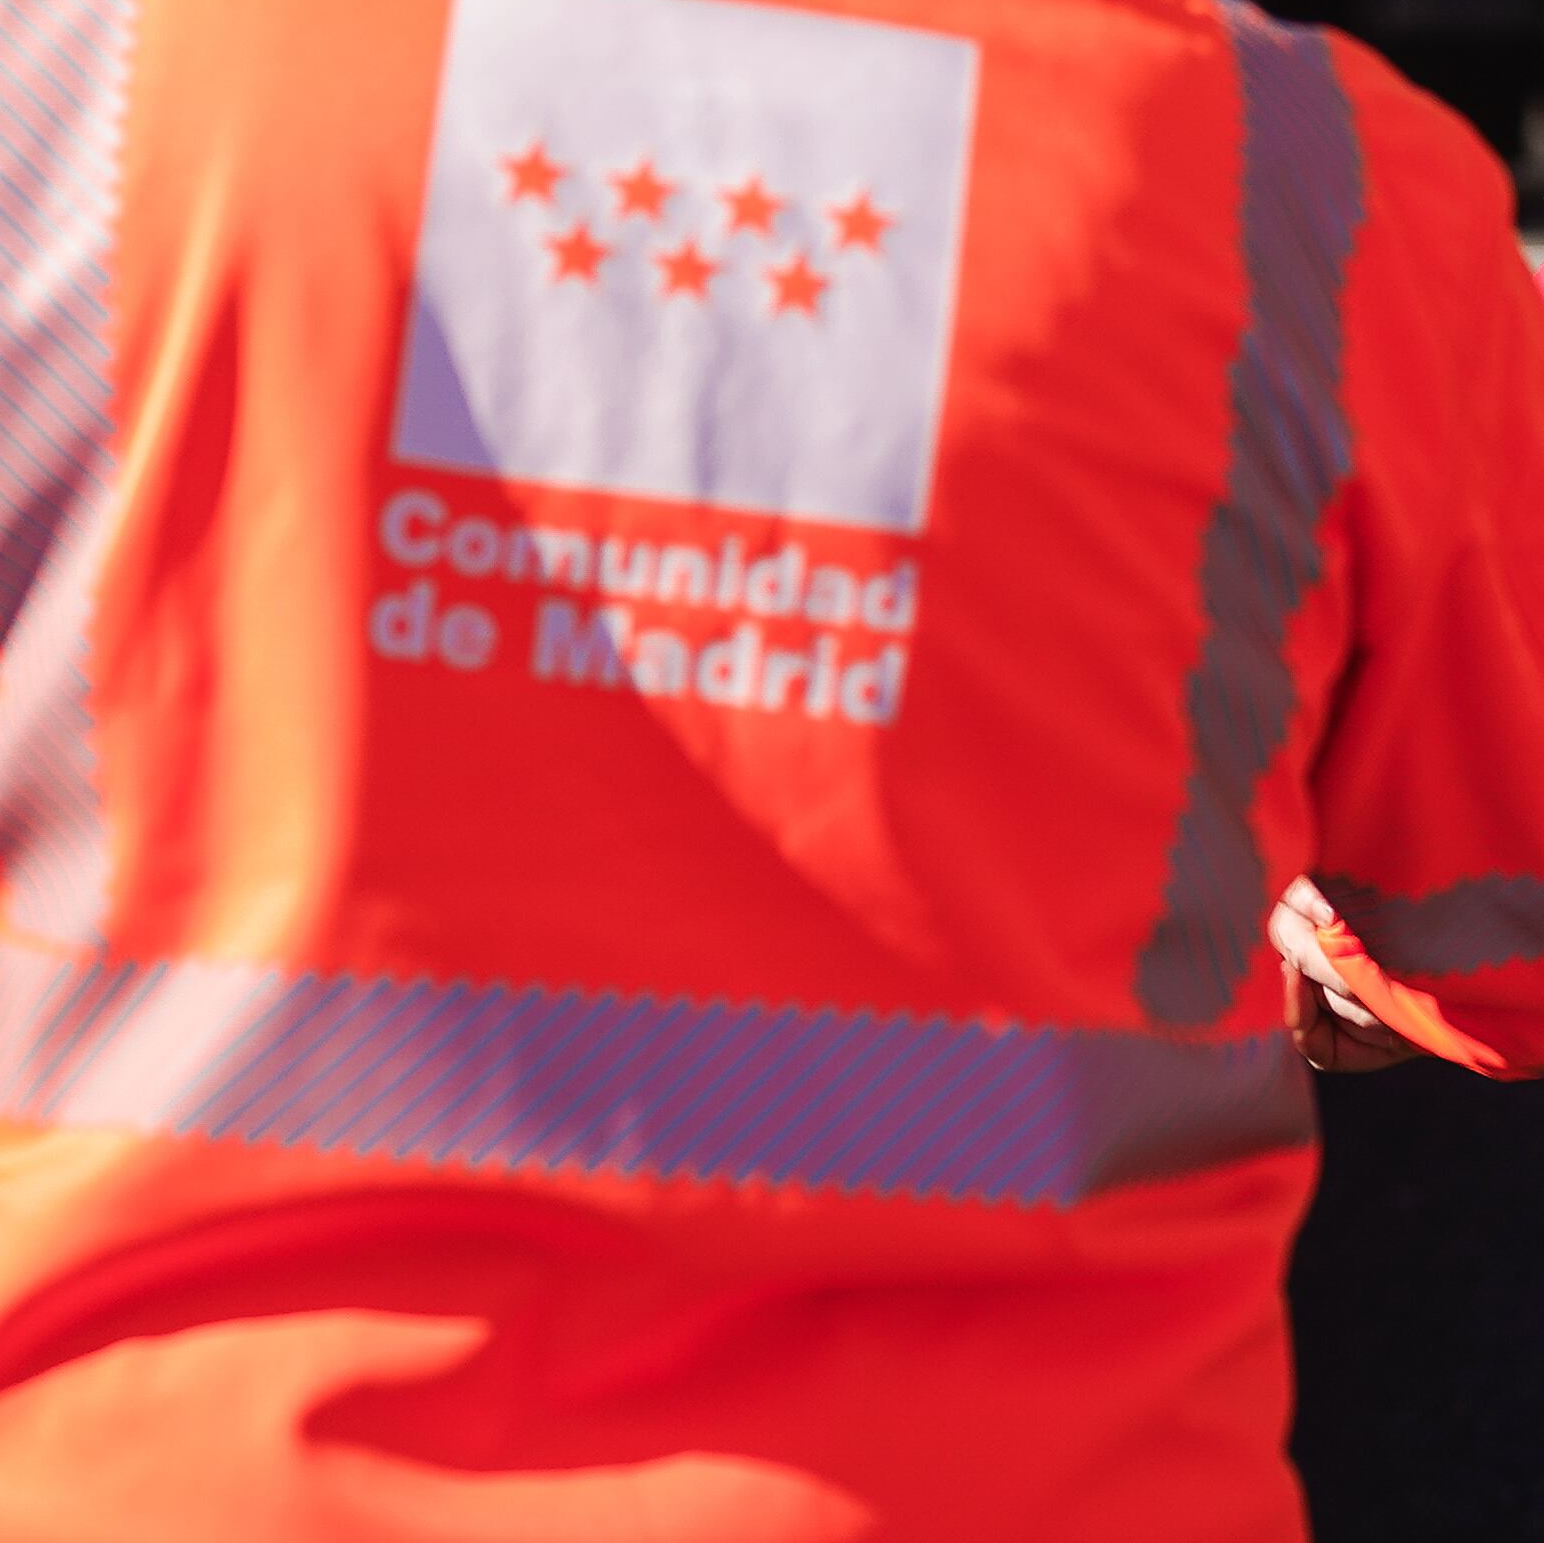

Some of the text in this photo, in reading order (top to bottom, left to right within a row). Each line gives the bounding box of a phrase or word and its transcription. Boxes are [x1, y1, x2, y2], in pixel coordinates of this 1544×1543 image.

[379, 488, 918, 633] Comunidad
[368, 577, 906, 726] de Madrid
